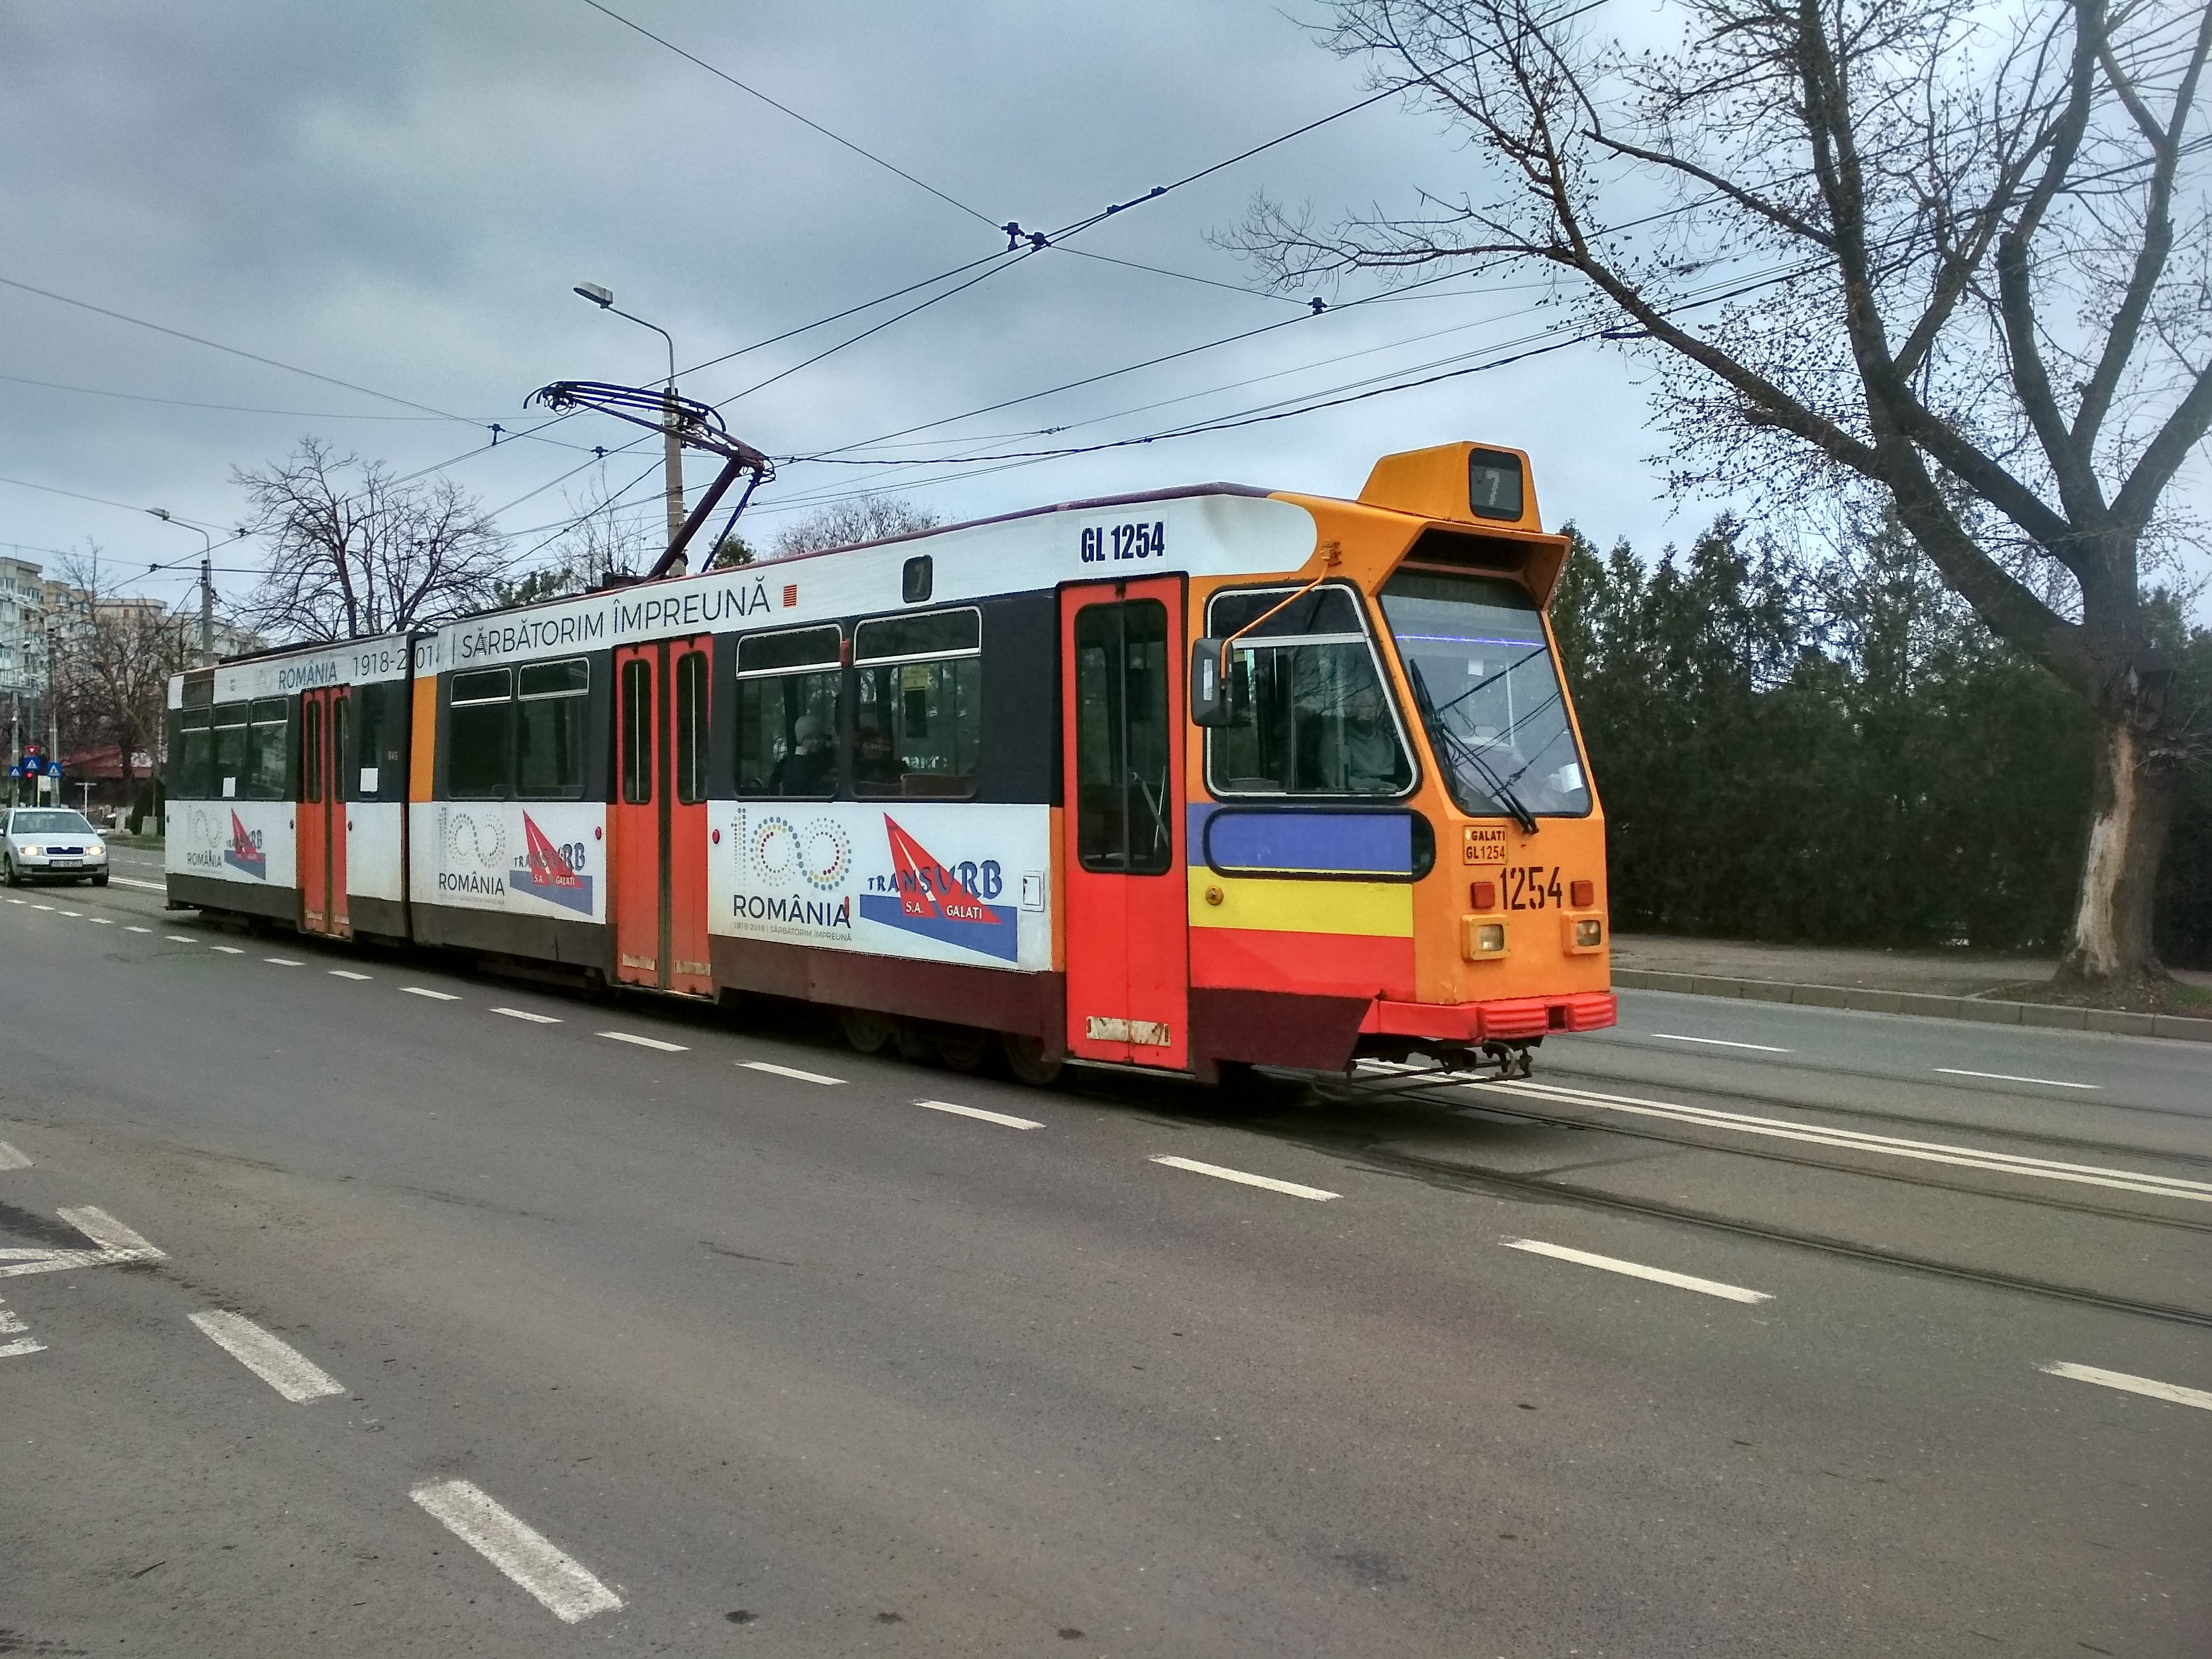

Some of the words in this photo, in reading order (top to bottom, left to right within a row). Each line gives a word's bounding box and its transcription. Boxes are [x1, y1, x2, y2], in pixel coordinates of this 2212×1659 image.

[1486, 469, 1499, 506] 7
[1081, 527, 1105, 563] GL
[1110, 521, 1165, 560] 1254
[278, 660, 337, 690] ROMÂNIA
[462, 611, 604, 658] SĂRBĂTORIM
[613, 575, 771, 634] ÎMPREUNĂ
[1471, 831, 1505, 841] GALATI
[439, 870, 505, 896] ROMÂNIA
[556, 876, 575, 886] GALATI
[867, 859, 1002, 900] TRANSURB
[1500, 866, 1563, 910] 1254
[733, 893, 851, 929] ROMÂNIA
[905, 901, 924, 914] S.A.
[946, 904, 982, 919] GALATI
[769, 924, 812, 937] SĂRBĂTORIM
[814, 929, 852, 942] ÎMPREUNĂ
